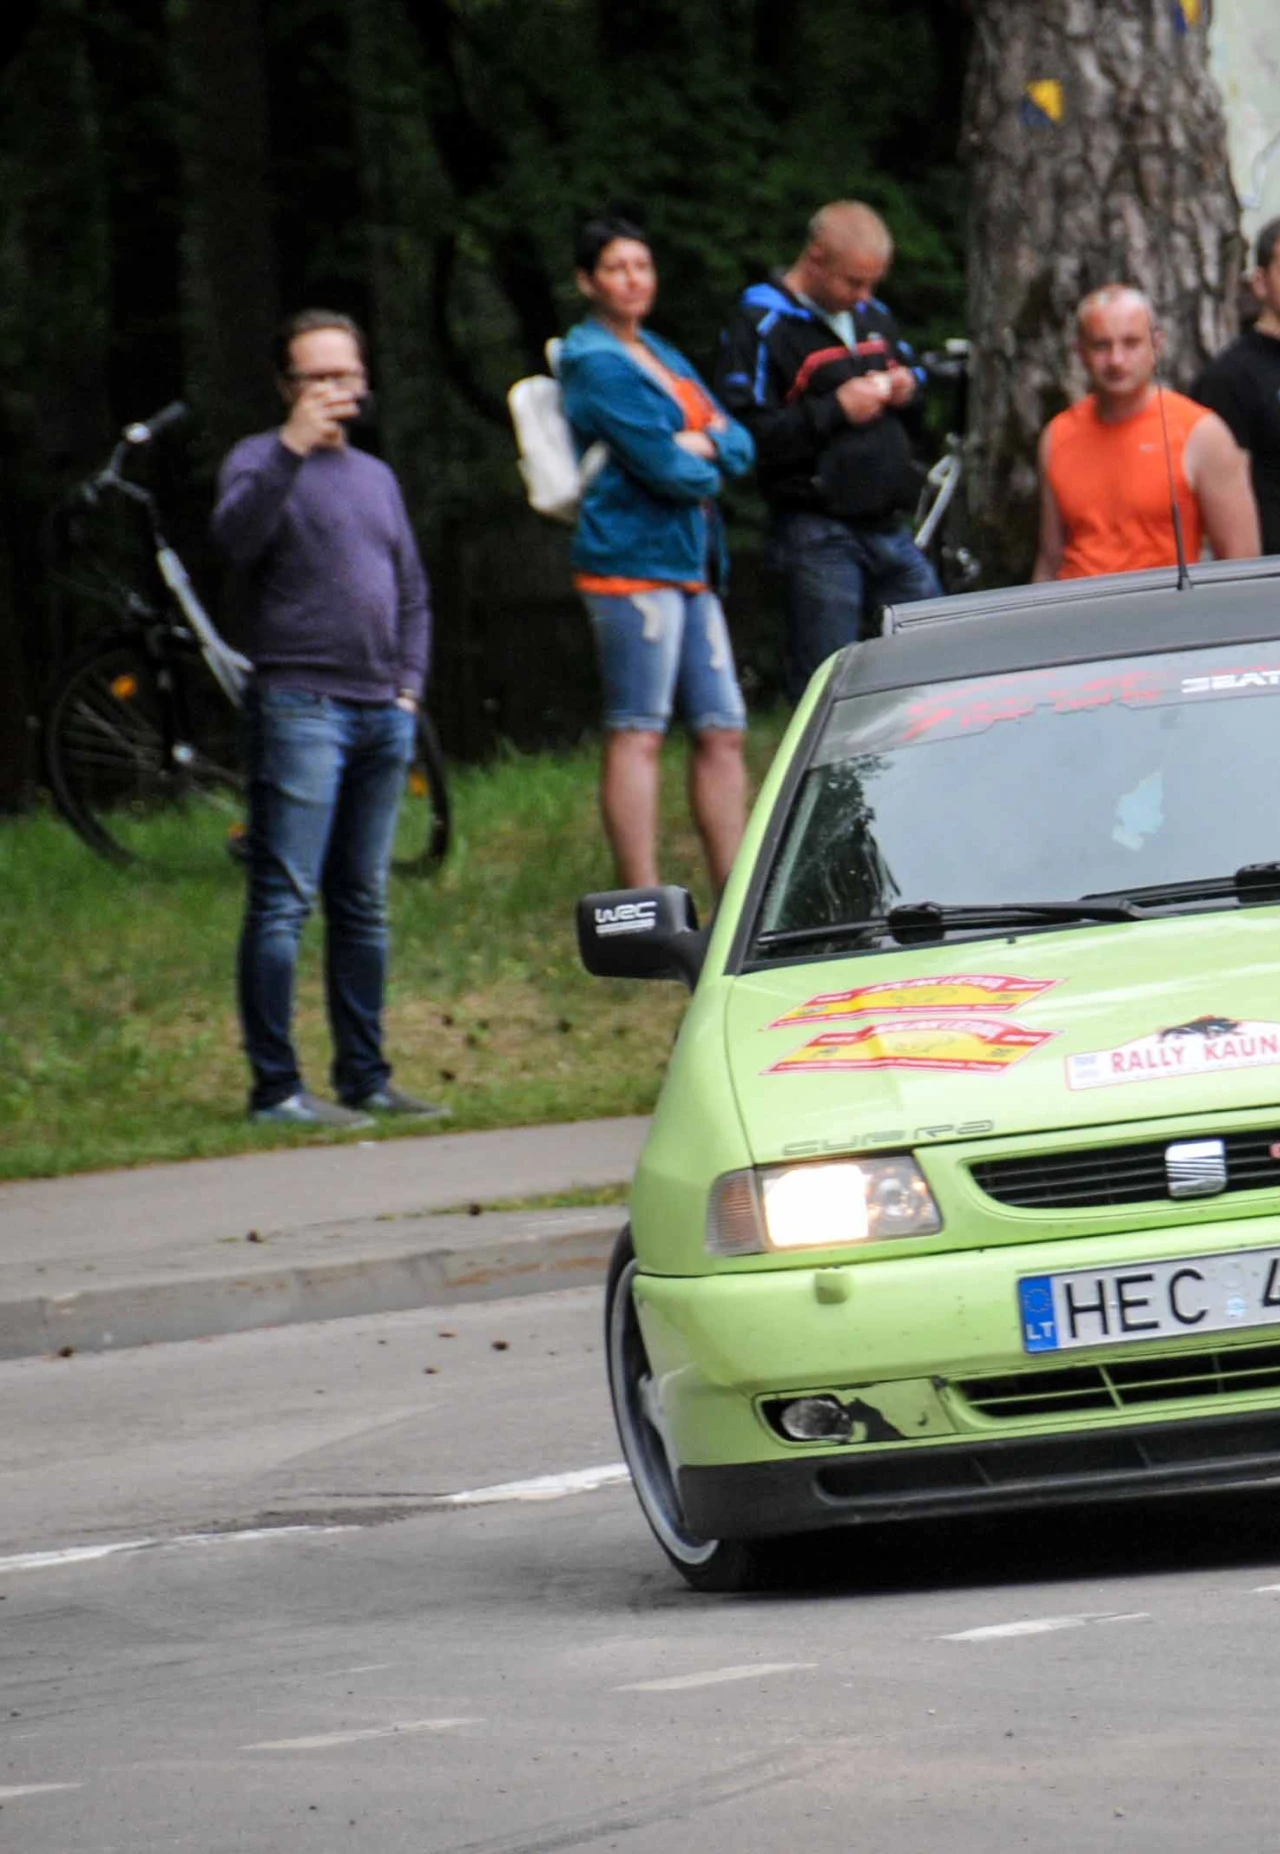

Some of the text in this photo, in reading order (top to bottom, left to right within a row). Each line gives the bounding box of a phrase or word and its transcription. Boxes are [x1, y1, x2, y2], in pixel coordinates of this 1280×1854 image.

[594, 901, 658, 924] WRC
[1110, 1045, 1186, 1074] RALLY
[1064, 1268, 1210, 1339] HEC
[1026, 1319, 1054, 1340] LT
